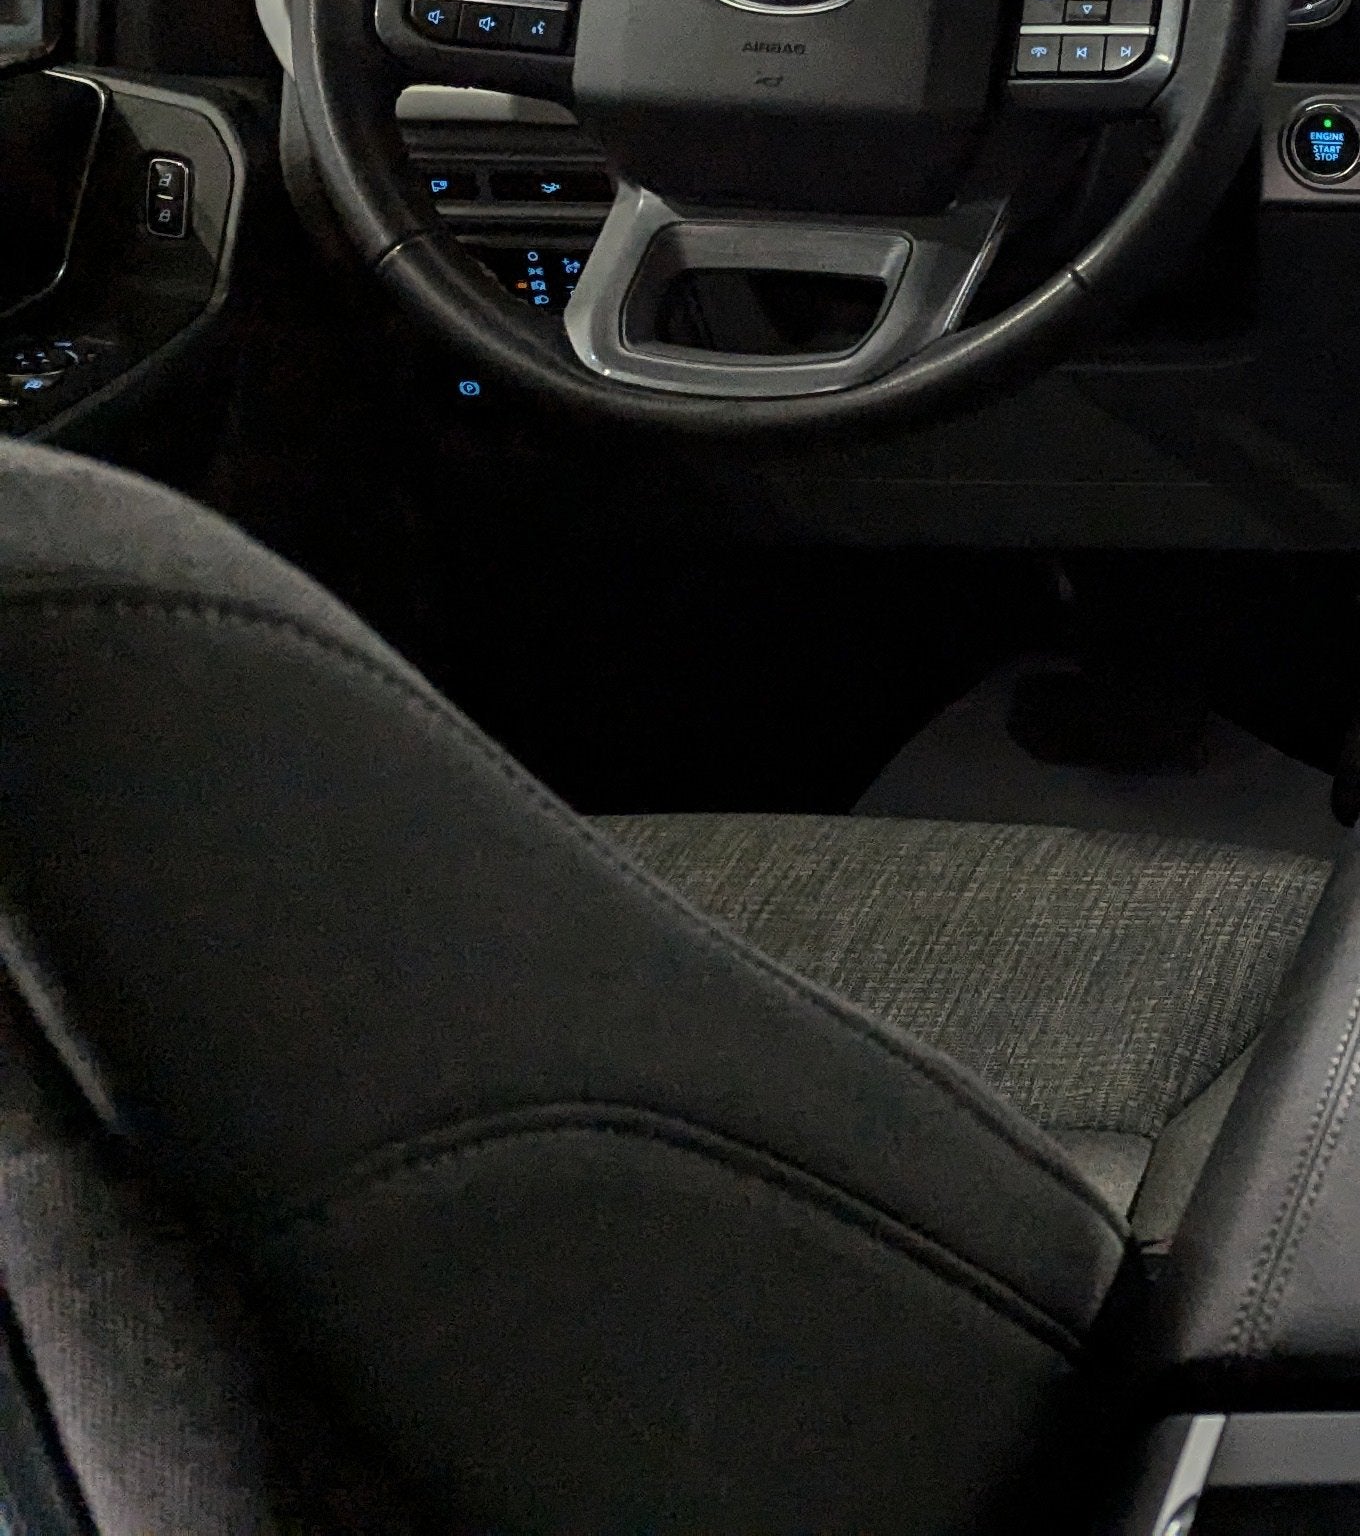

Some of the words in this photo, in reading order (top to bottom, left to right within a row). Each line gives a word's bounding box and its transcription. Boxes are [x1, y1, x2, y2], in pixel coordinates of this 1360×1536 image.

[742, 41, 807, 55] AIRBAG
[1310, 131, 1345, 141] ENGINE
[1313, 145, 1341, 153] START
[1314, 153, 1339, 161] STOP
